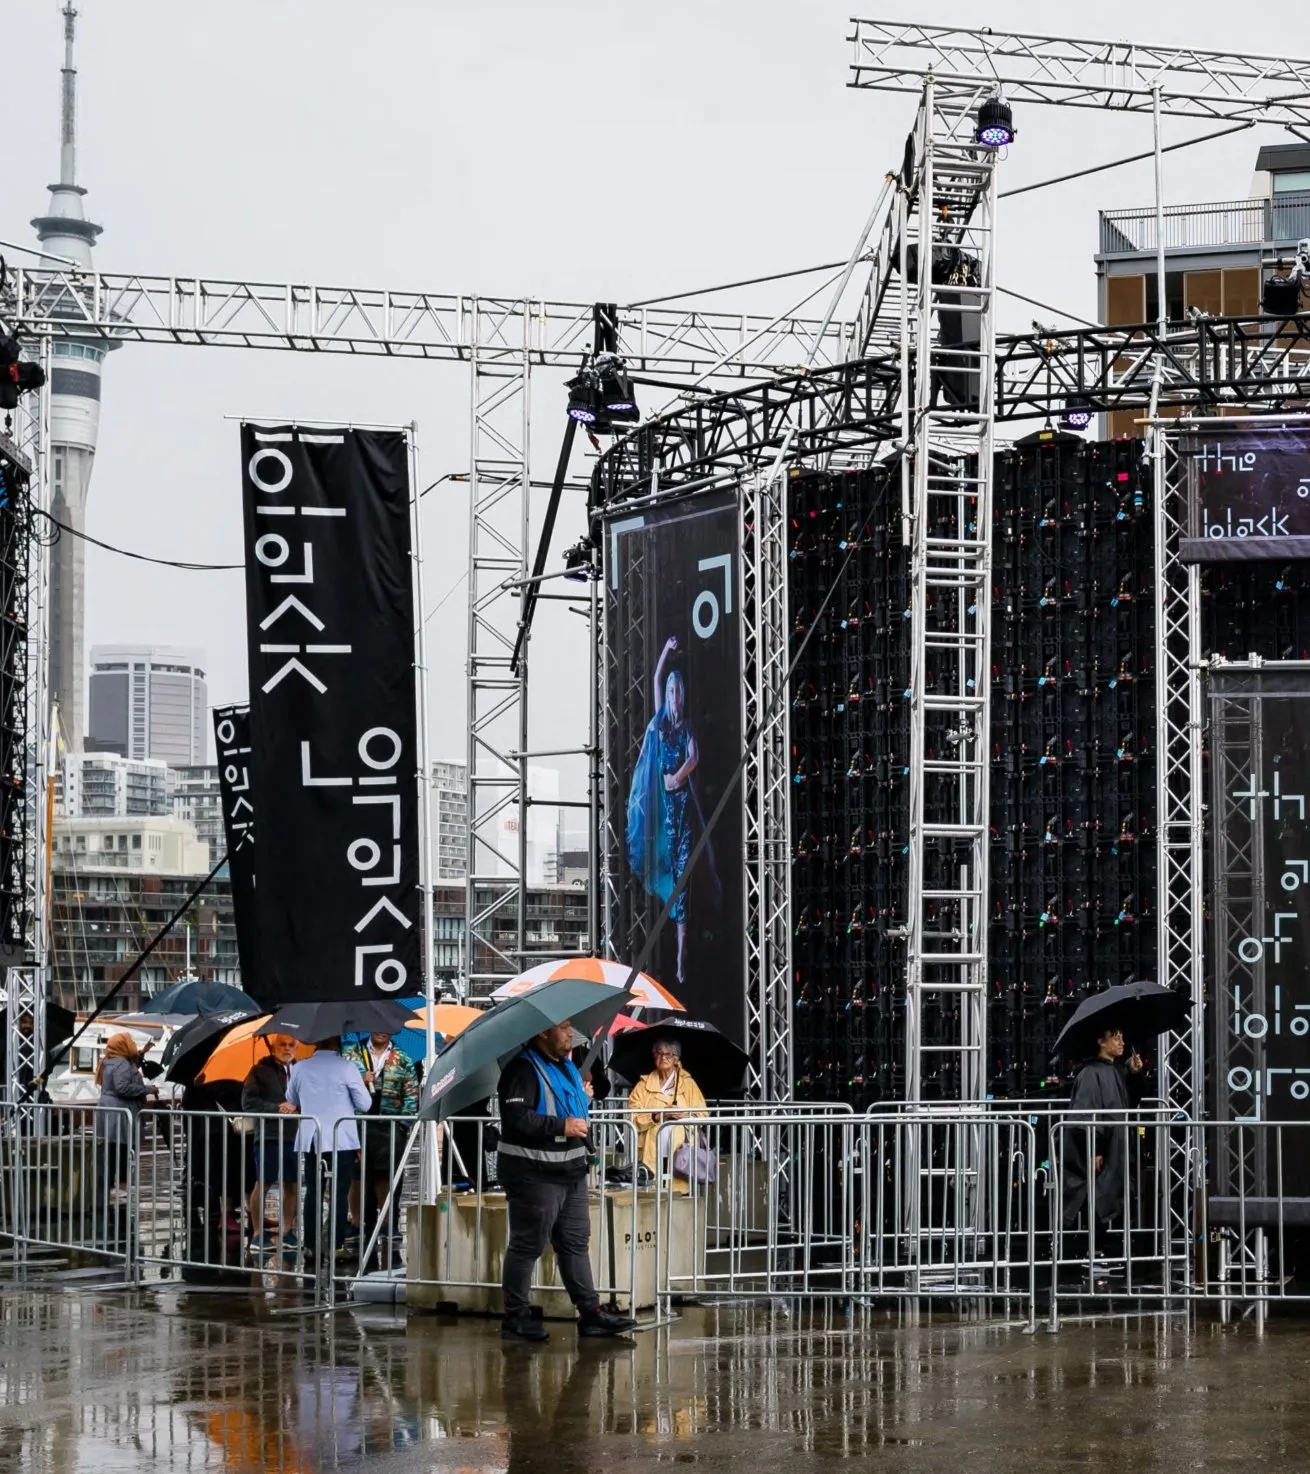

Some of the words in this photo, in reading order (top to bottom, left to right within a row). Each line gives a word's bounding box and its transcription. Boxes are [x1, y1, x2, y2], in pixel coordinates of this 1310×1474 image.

[1193, 443, 1256, 472] the
[1204, 507, 1289, 539] black
[249, 433, 351, 693] black
[301, 727, 411, 991] grace
[1238, 912, 1298, 963] of
[624, 1231, 657, 1244] PLO
